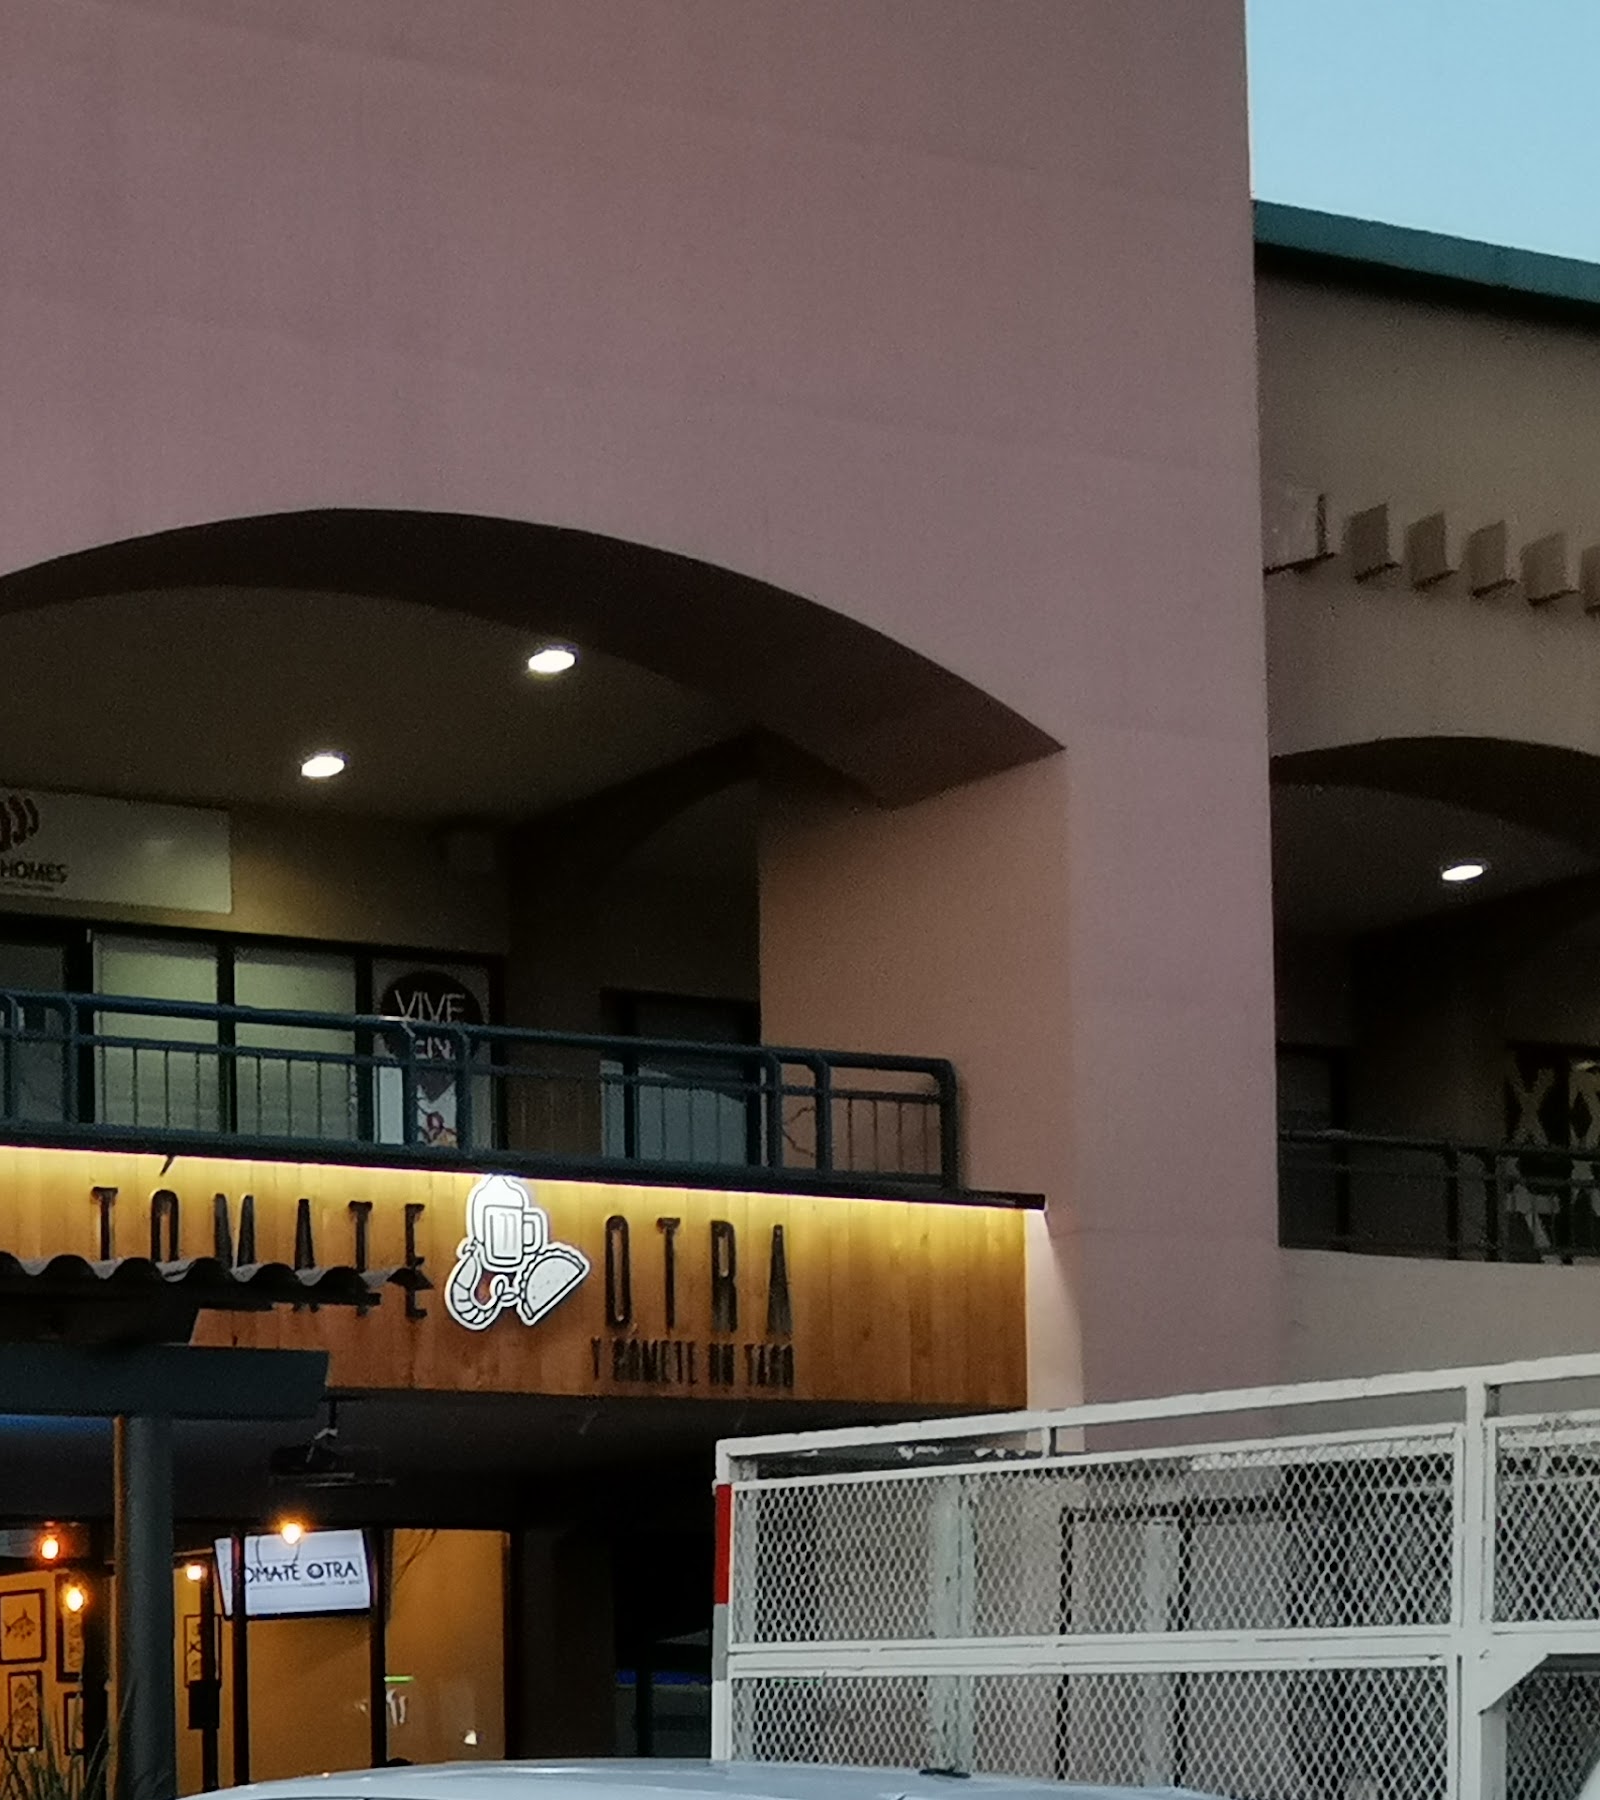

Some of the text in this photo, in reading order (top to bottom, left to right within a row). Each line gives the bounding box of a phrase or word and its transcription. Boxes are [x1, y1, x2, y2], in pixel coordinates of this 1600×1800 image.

[0, 858, 69, 884] HOMES
[394, 989, 466, 1024] VIVE
[604, 1213, 795, 1335] OTRA
[245, 1563, 301, 1584] OMATE
[306, 1560, 359, 1580] OTRA
